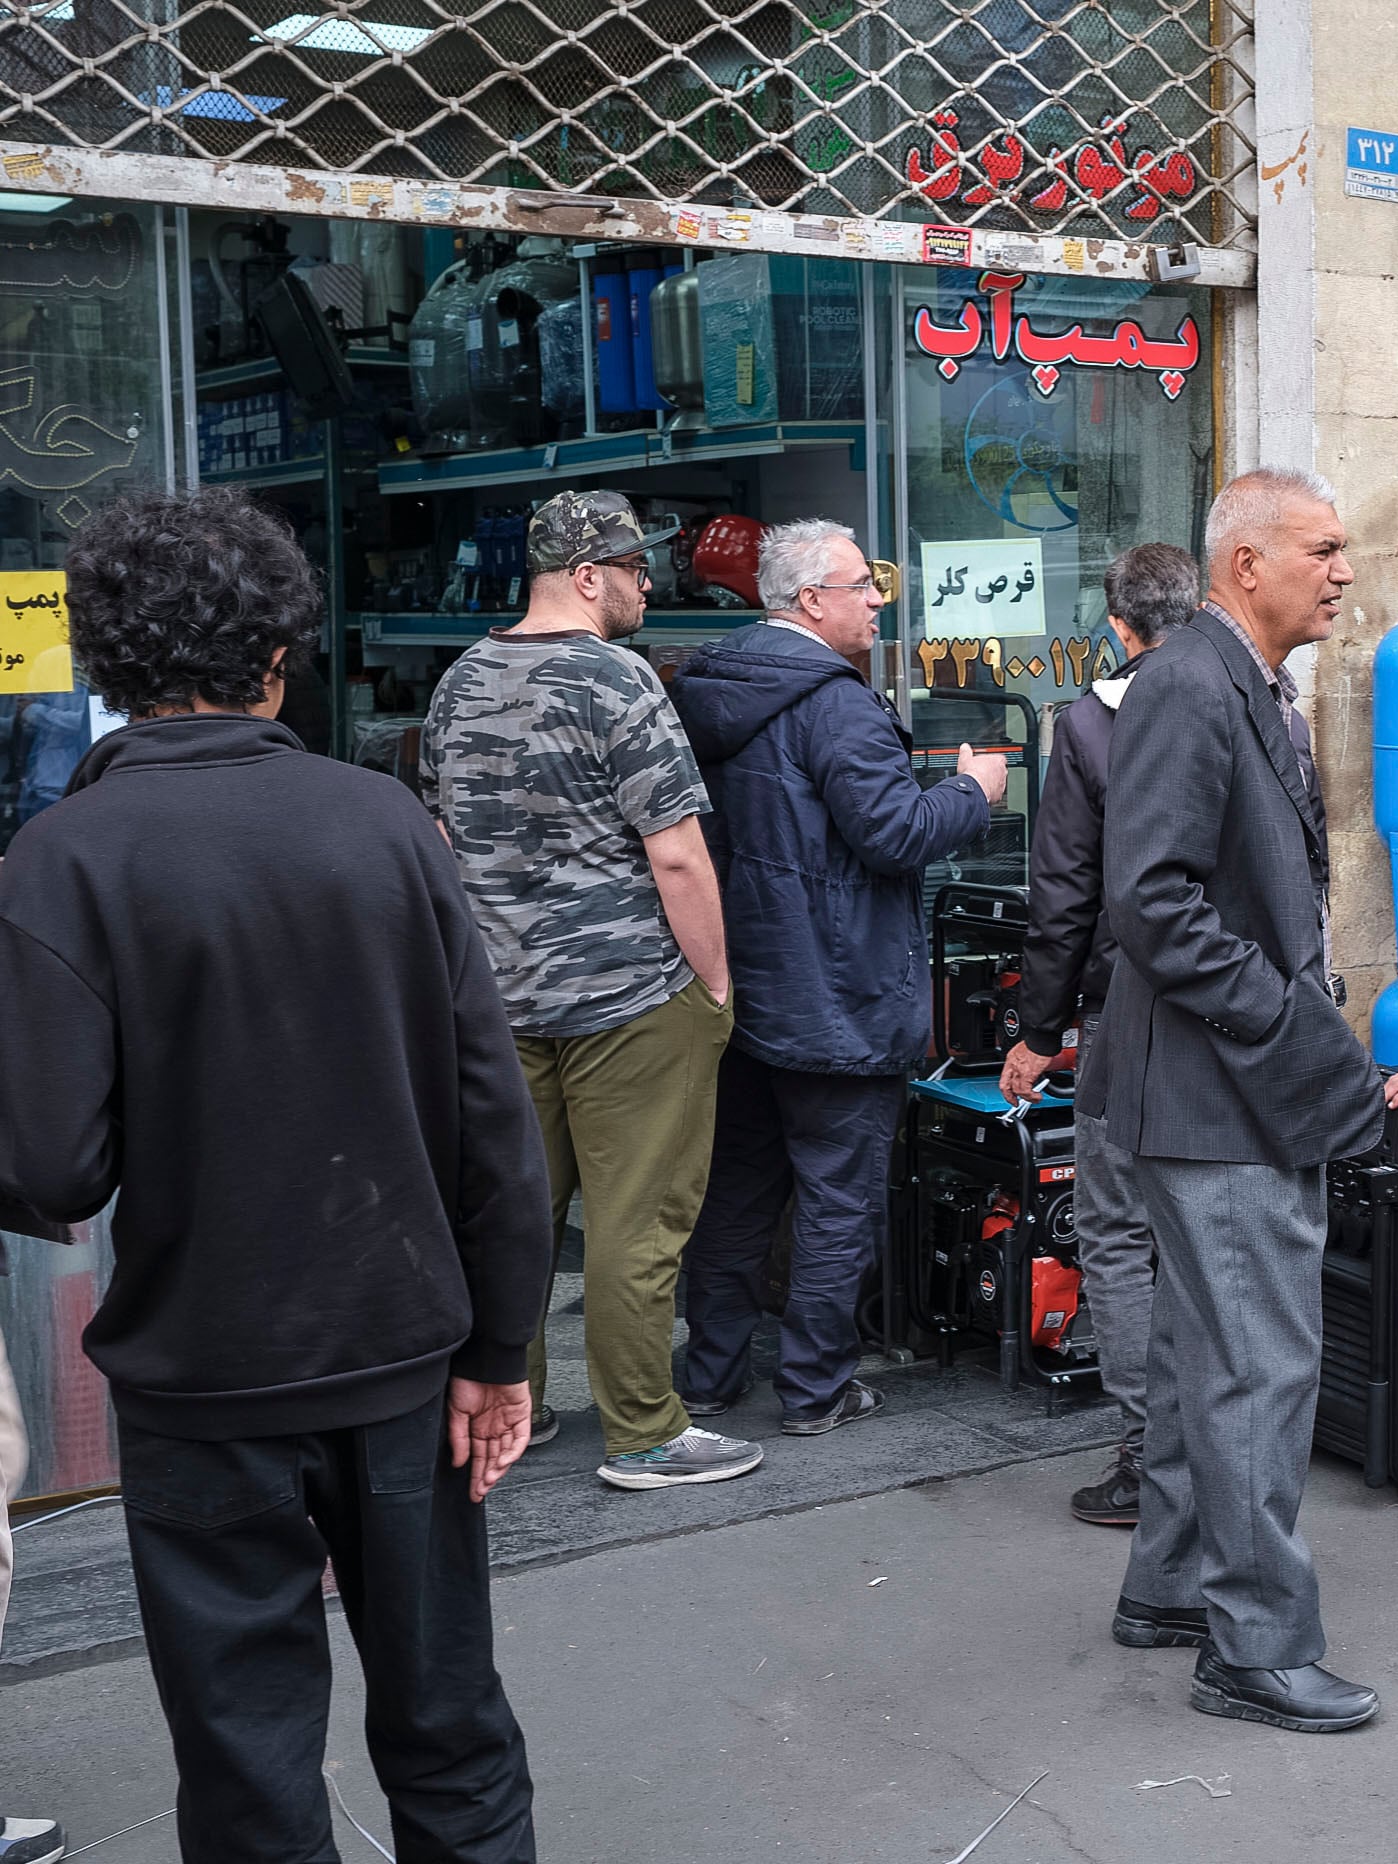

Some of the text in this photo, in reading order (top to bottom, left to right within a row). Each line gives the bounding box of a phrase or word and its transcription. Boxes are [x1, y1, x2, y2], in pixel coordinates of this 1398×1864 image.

[1357, 137, 1395, 165] ۳۱۲
[914, 270, 1200, 402] پمپ آب
[6, 590, 62, 620] پمپ
[931, 561, 1036, 607] قرص کلر
[917, 636, 1120, 689] ۳۳۹۰۰۱۲۵
